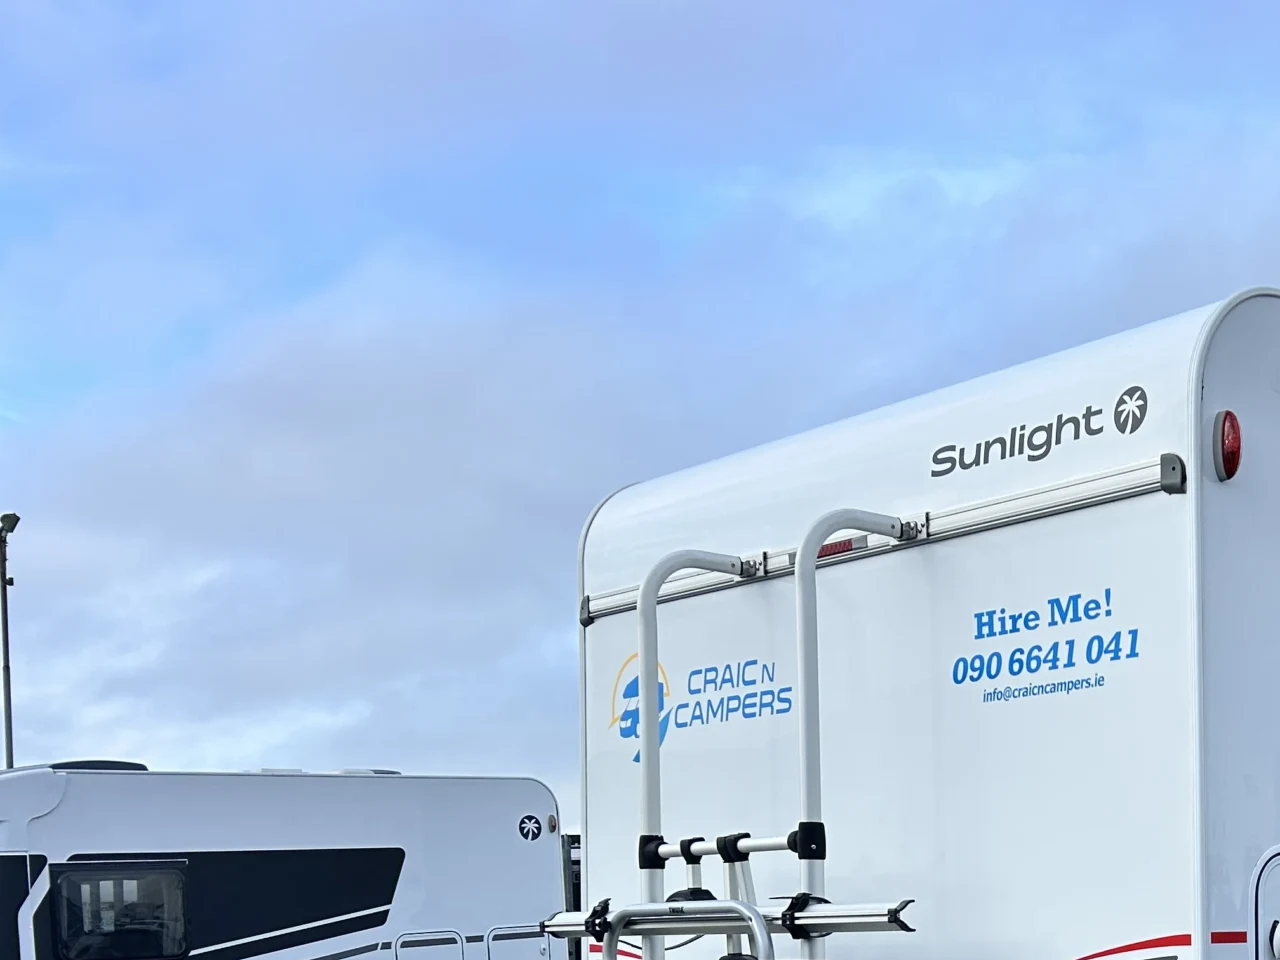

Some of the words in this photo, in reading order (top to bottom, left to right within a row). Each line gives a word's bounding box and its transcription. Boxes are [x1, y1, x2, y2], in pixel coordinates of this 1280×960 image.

[930, 405, 1104, 478] Sunlight
[973, 608, 1040, 640] Hire
[1047, 588, 1112, 627] Me!
[688, 659, 758, 695] CRAIC
[761, 662, 776, 684] N
[952, 651, 1003, 685] 090
[1008, 639, 1076, 677] 6641
[1085, 628, 1140, 664] 041
[674, 686, 793, 729] CAMPERS
[982, 673, 1105, 703] info@craicncampers.ie
